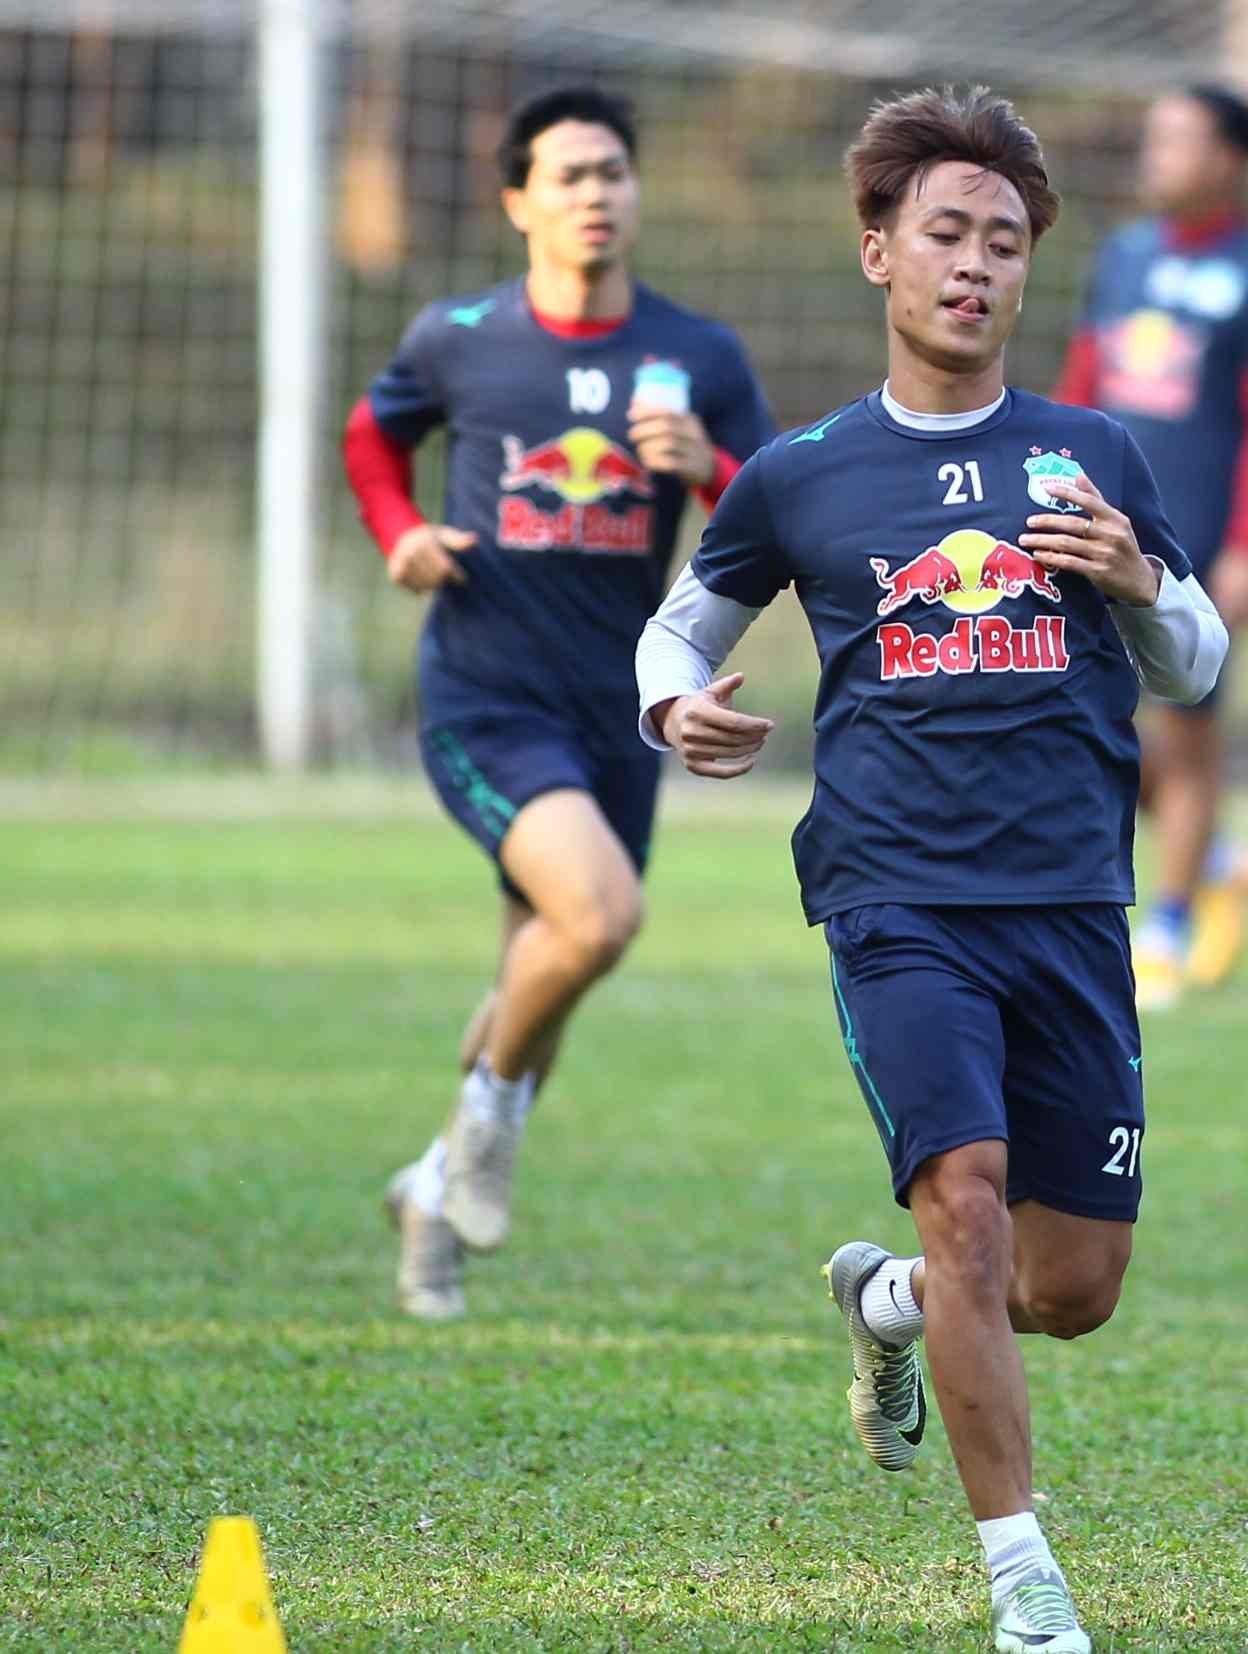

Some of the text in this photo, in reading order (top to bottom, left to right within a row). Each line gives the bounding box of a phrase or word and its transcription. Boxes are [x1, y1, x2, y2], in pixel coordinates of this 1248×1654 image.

[565, 367, 611, 414] 10
[937, 460, 984, 506] 21
[497, 495, 656, 554] Red Bull
[876, 615, 1071, 681] Red Bull
[1101, 1126, 1141, 1178] 21
